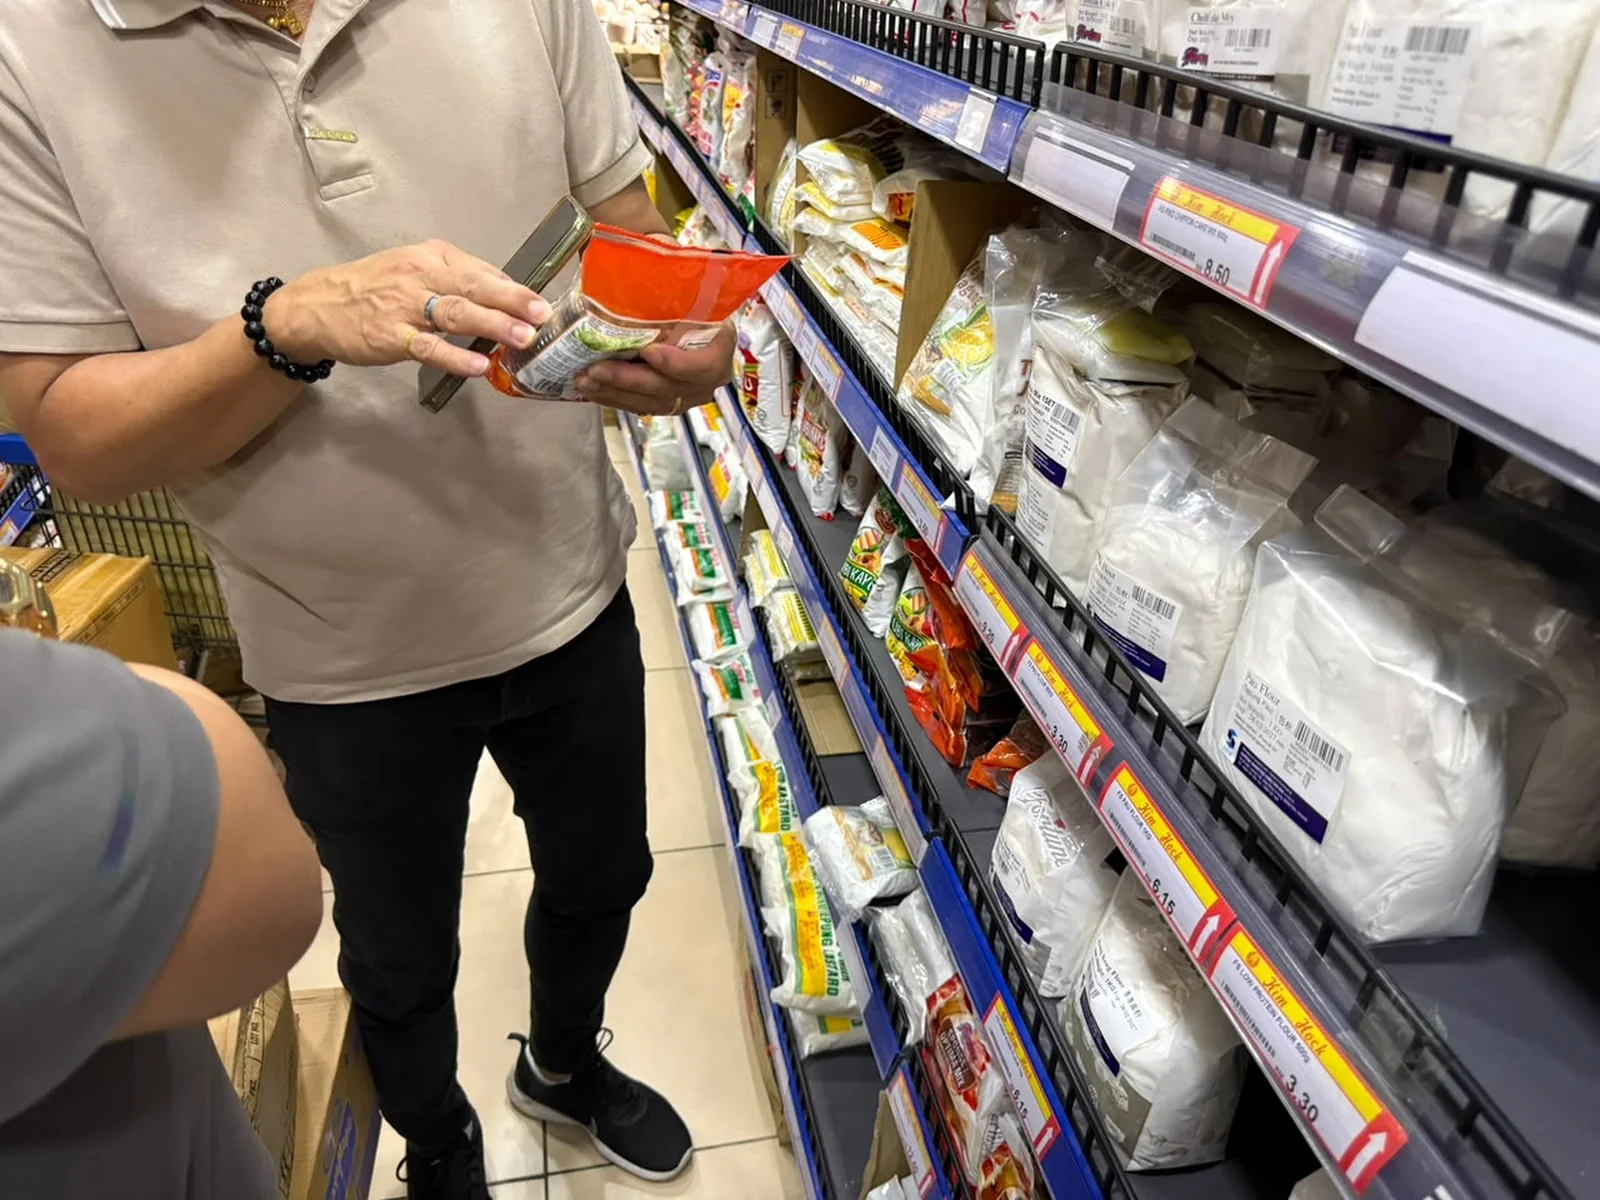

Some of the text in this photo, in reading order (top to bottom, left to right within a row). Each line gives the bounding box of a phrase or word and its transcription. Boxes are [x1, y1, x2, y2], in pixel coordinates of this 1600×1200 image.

[1204, 258, 1230, 286] 8.50
[1258, 682, 1281, 706] Flour
[1051, 725, 1068, 753] 3.30
[1139, 803, 1183, 861] Kim Hock
[1152, 879, 1176, 915] 6.15
[1232, 958, 1242, 971] FS
[1239, 969, 1254, 987] LOW
[1252, 985, 1280, 1018] PROTEIN
[1275, 1015, 1297, 1044] FLOUR
[1263, 976, 1325, 1057] Kim Hock
[954, 1067, 965, 1087] MIX
[1014, 1088, 1029, 1120] 6.15
[1286, 1074, 1319, 1122] 3.30
